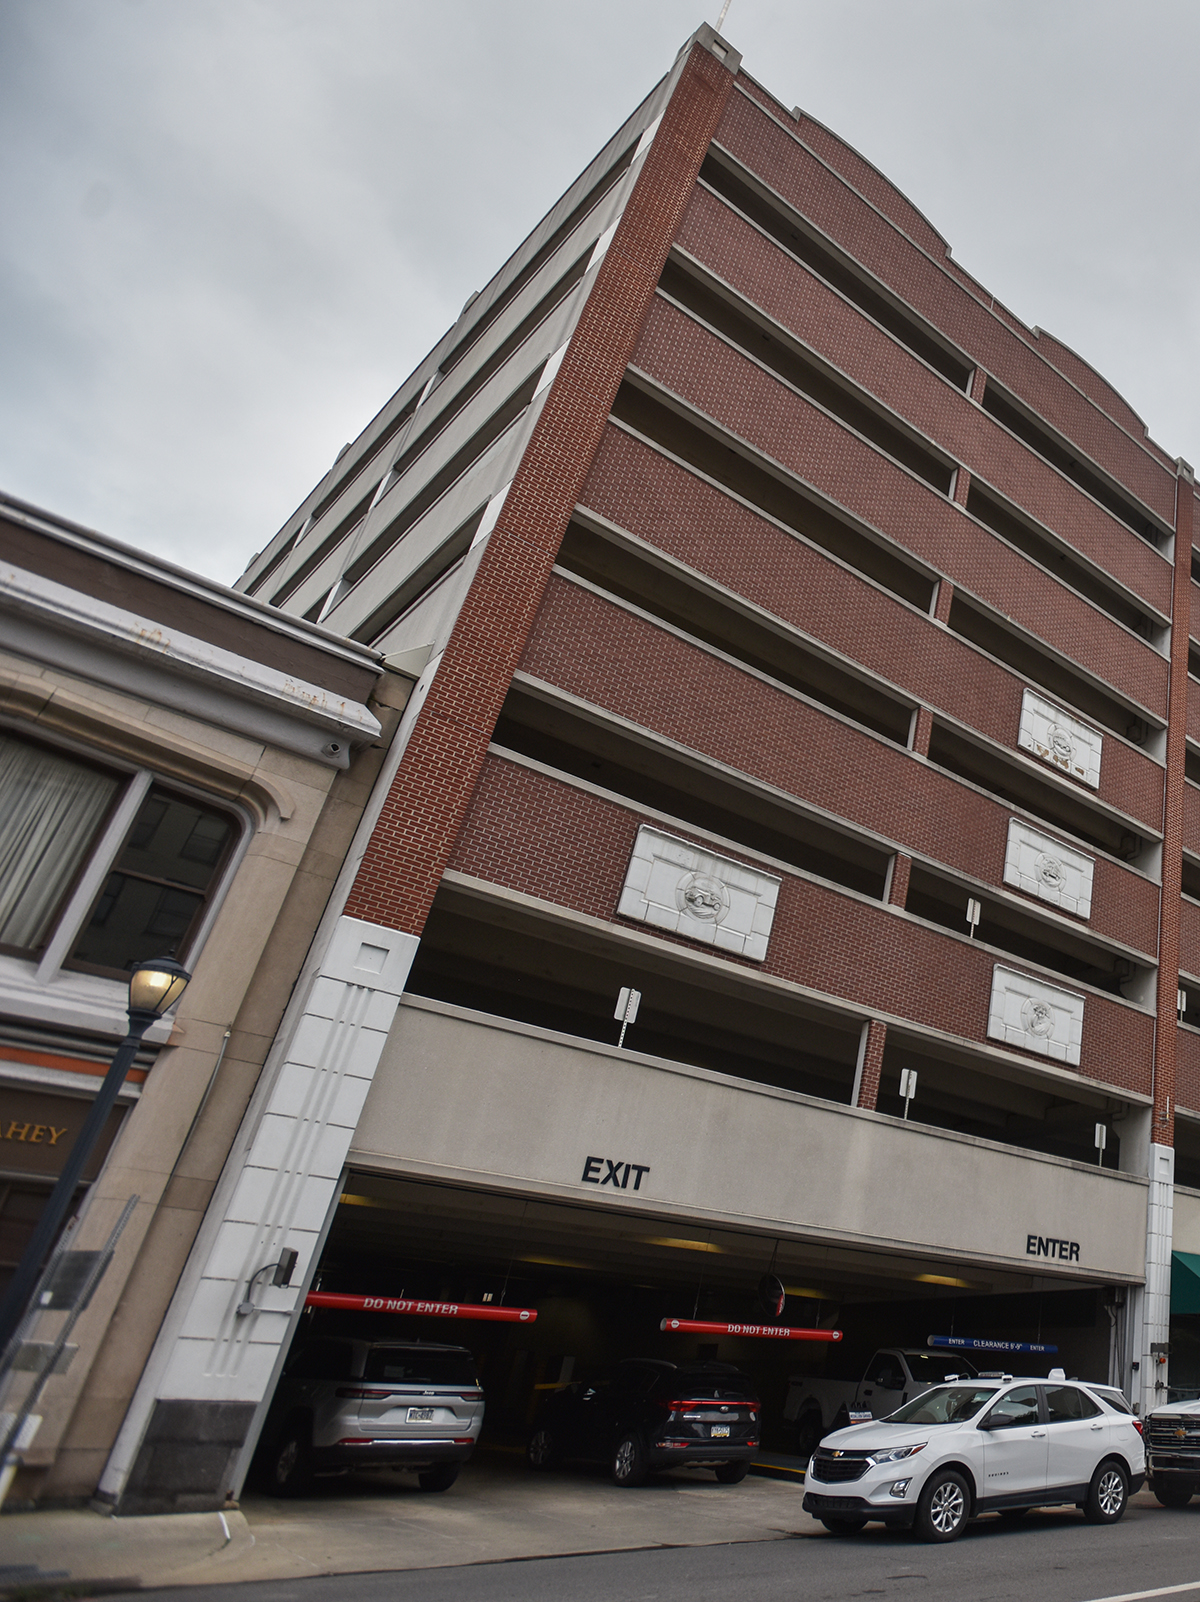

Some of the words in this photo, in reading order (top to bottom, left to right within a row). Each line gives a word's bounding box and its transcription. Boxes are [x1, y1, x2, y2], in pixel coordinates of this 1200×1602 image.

[581, 1156, 650, 1190] EXIT
[1026, 1234, 1080, 1262] ENTER
[363, 1298, 384, 1309] DO
[386, 1300, 414, 1311] NOT
[415, 1302, 459, 1315] ENTER
[727, 1324, 741, 1333] DO
[742, 1326, 760, 1335] NOT
[762, 1328, 790, 1336] ENTER
[973, 1340, 1009, 1349] CLEARANCE
